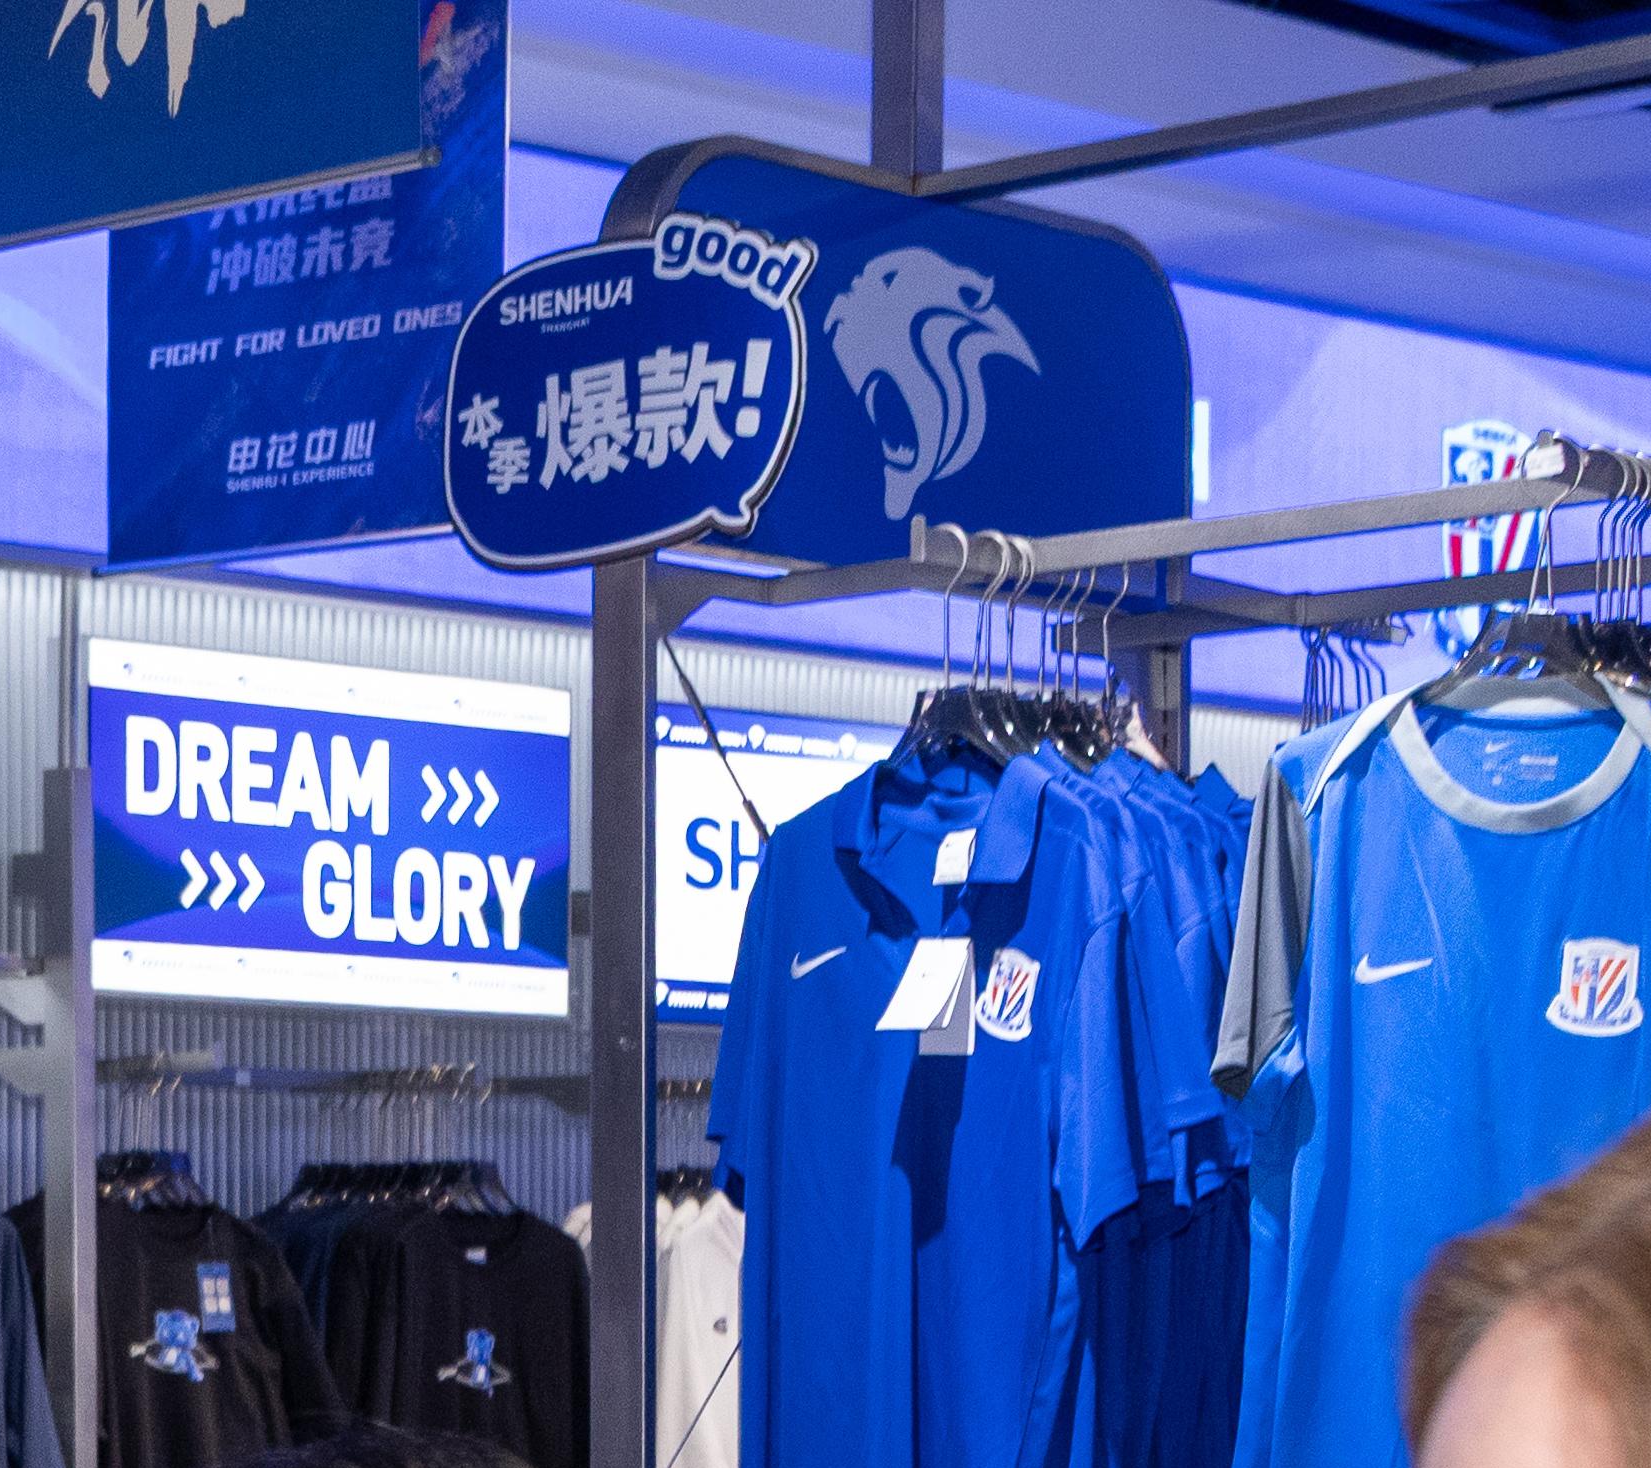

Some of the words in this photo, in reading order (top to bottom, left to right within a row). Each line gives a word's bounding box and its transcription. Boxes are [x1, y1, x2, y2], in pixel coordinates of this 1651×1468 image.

[661, 223, 800, 291] good
[499, 275, 634, 327] SHENHUA
[540, 316, 591, 334] SHANGHAI
[149, 337, 223, 370] FIGHT
[235, 328, 286, 357] FOR
[297, 314, 381, 348] LOVED
[393, 300, 463, 333] ONES
[227, 418, 377, 475] 申花中心
[292, 461, 375, 487] EXPERIENCE
[125, 714, 391, 837] DREAM
[303, 840, 536, 951] GLORY
